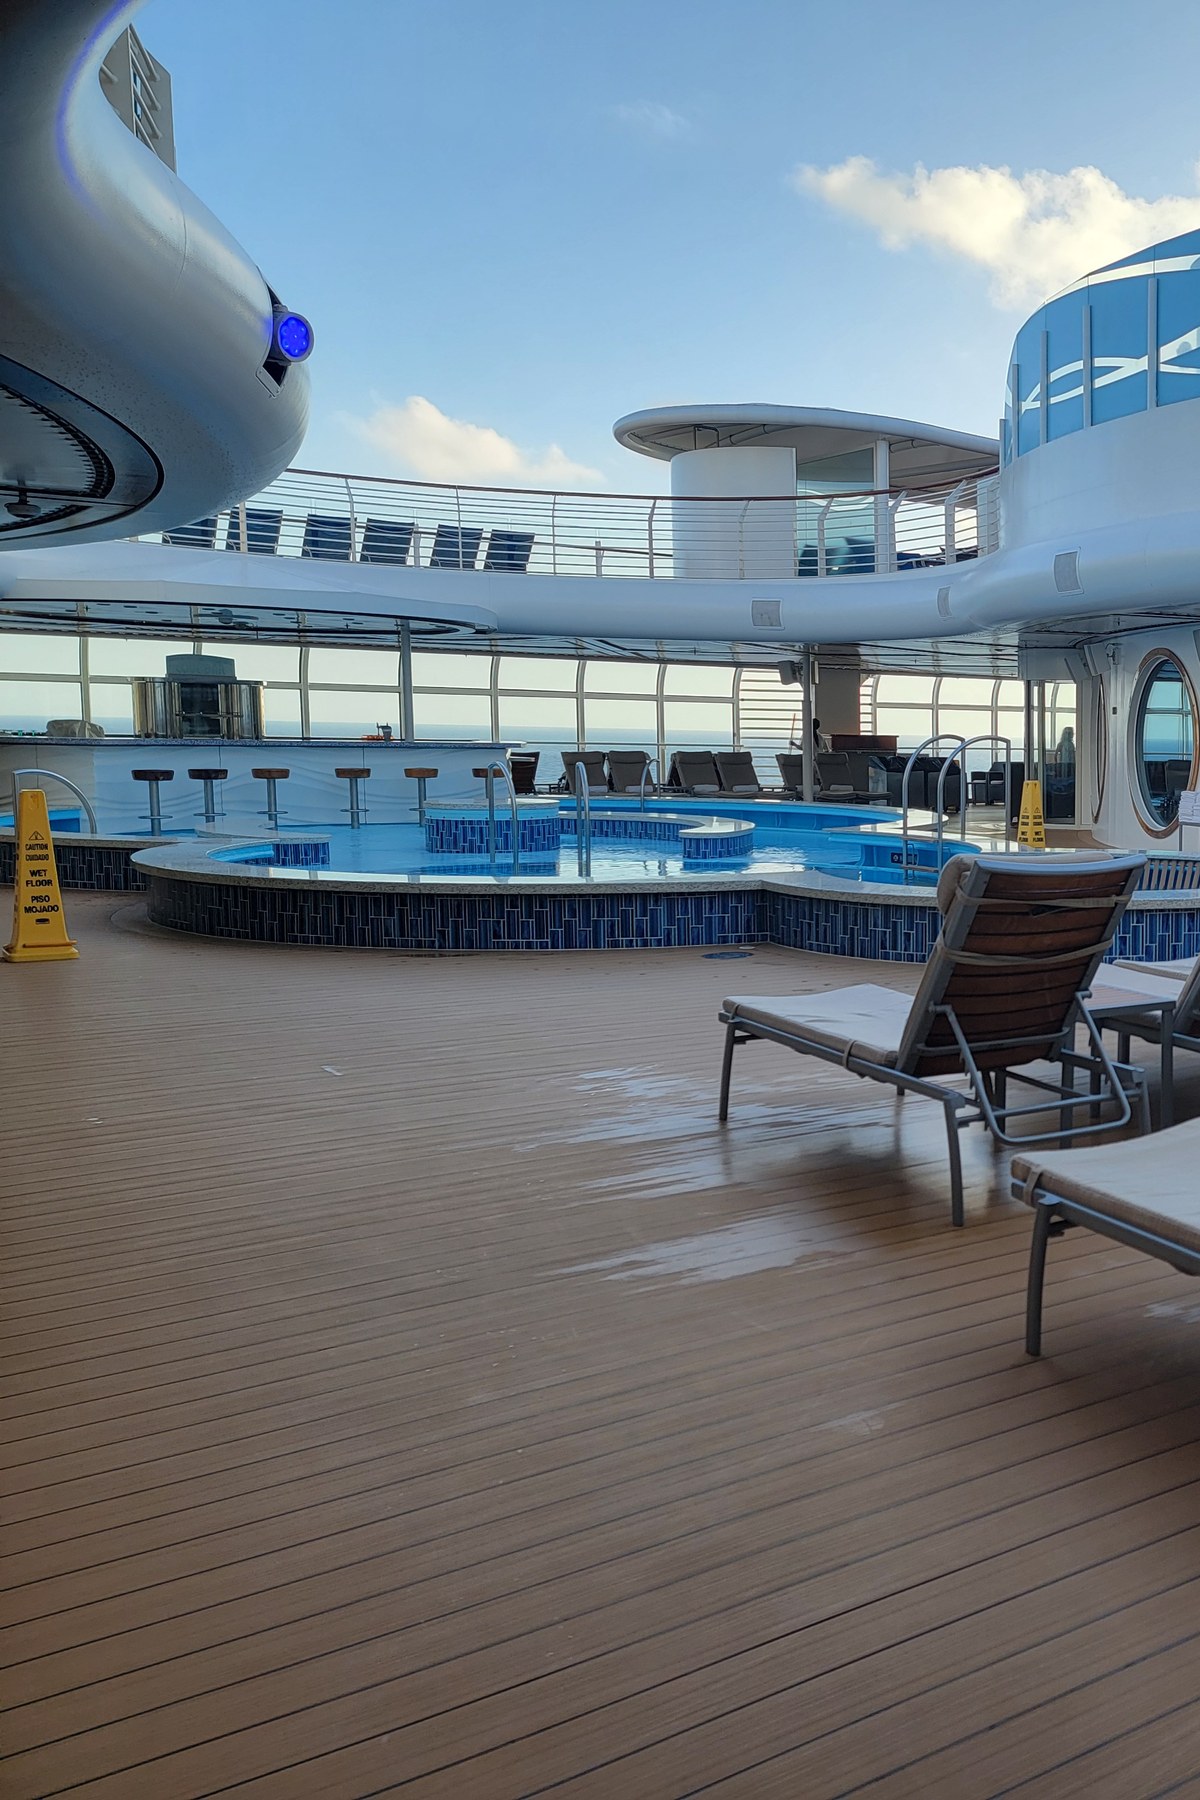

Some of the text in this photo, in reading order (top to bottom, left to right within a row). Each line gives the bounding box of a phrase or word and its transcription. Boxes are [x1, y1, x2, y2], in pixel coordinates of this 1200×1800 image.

[25, 843, 48, 851] CAUTION
[25, 853, 49, 861] CUIDADO
[29, 869, 48, 877] WET
[25, 879, 53, 888] FLOOR
[31, 895, 50, 904] PISO
[24, 904, 59, 914] MOJADO
